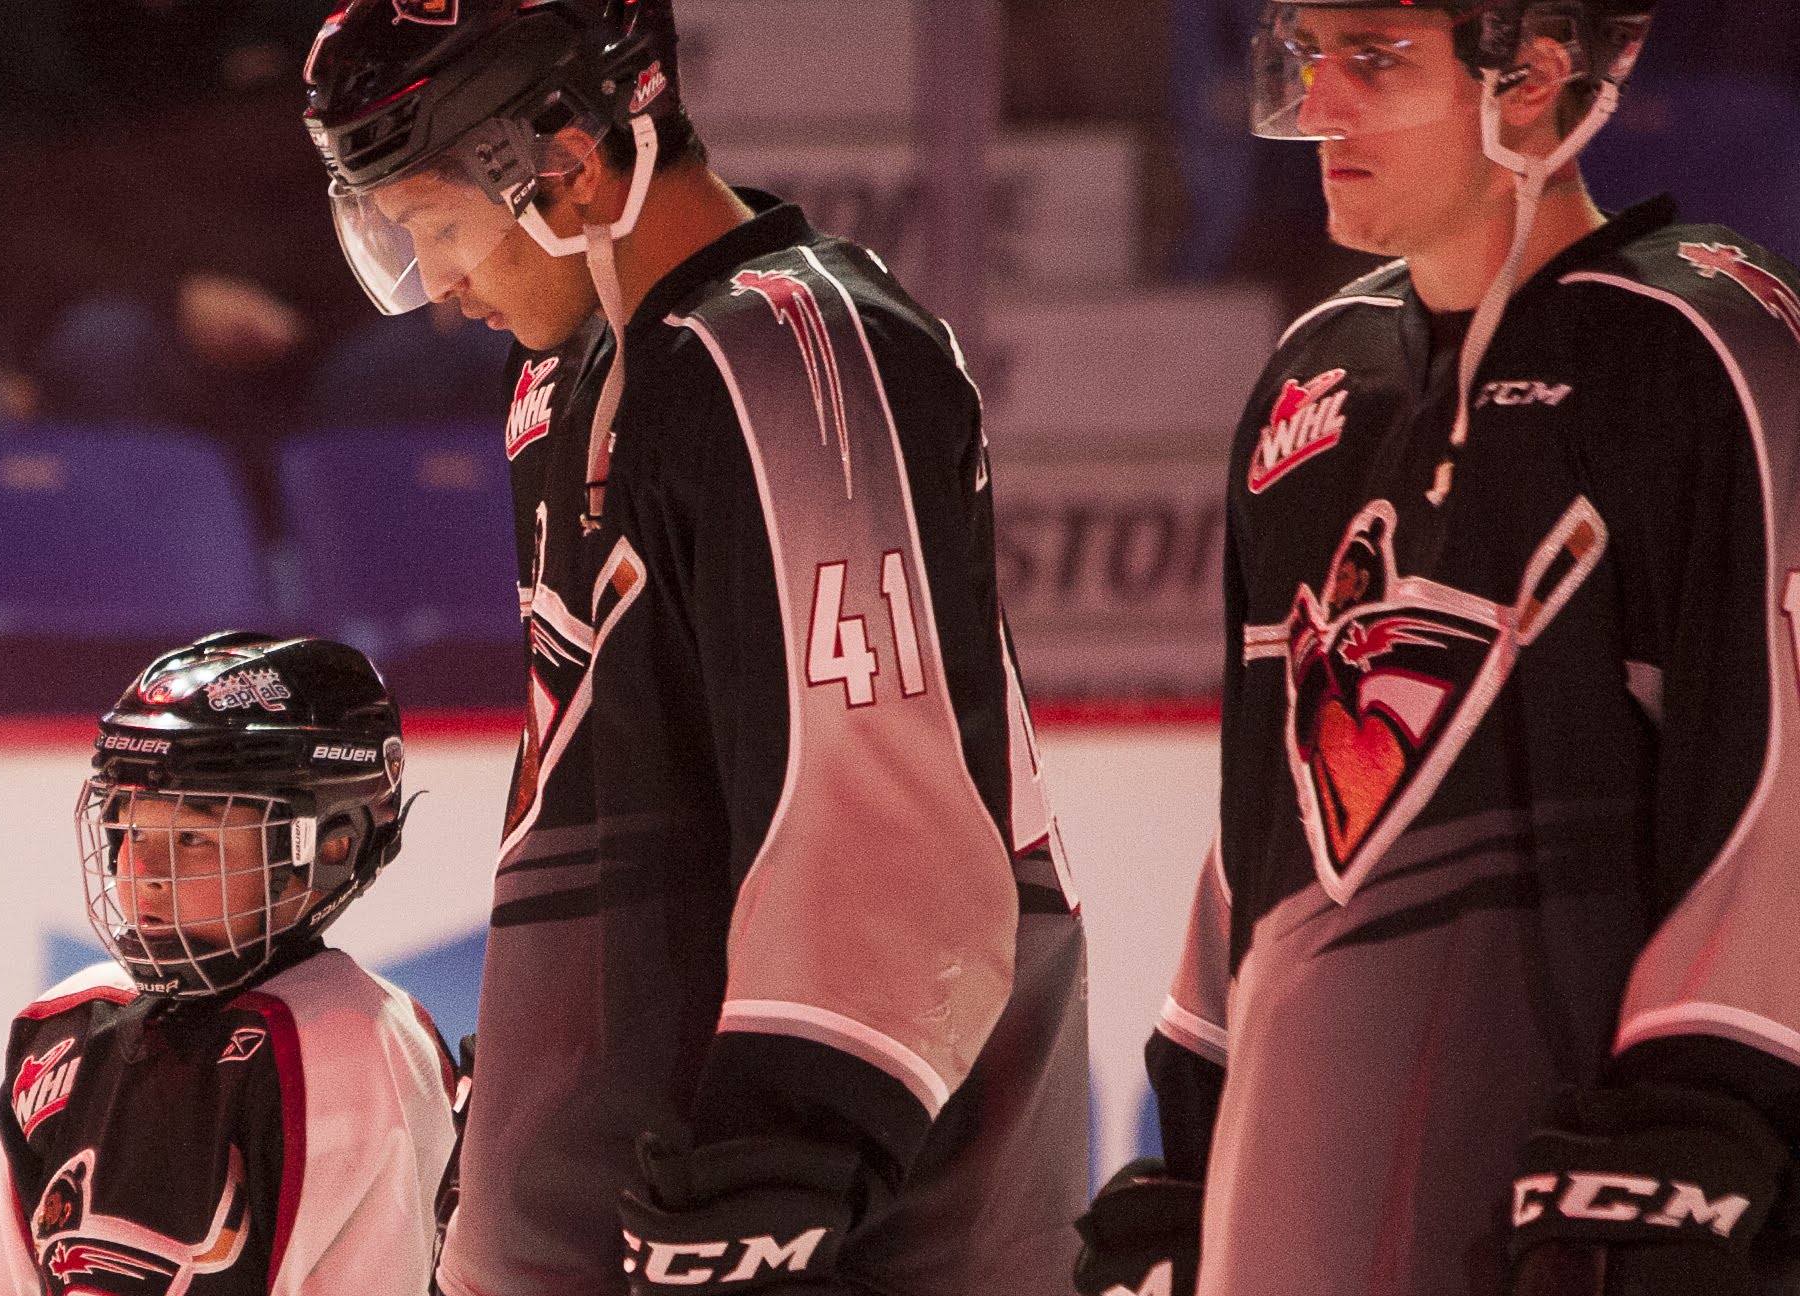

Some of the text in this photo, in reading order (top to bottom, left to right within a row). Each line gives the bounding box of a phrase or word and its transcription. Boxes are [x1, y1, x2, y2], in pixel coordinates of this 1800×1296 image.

[510, 382, 555, 441] WHL
[1258, 390, 1350, 470] WHL
[806, 549, 927, 709] 41
[135, 978, 180, 994] AUER
[1512, 1171, 1752, 1239] CCM
